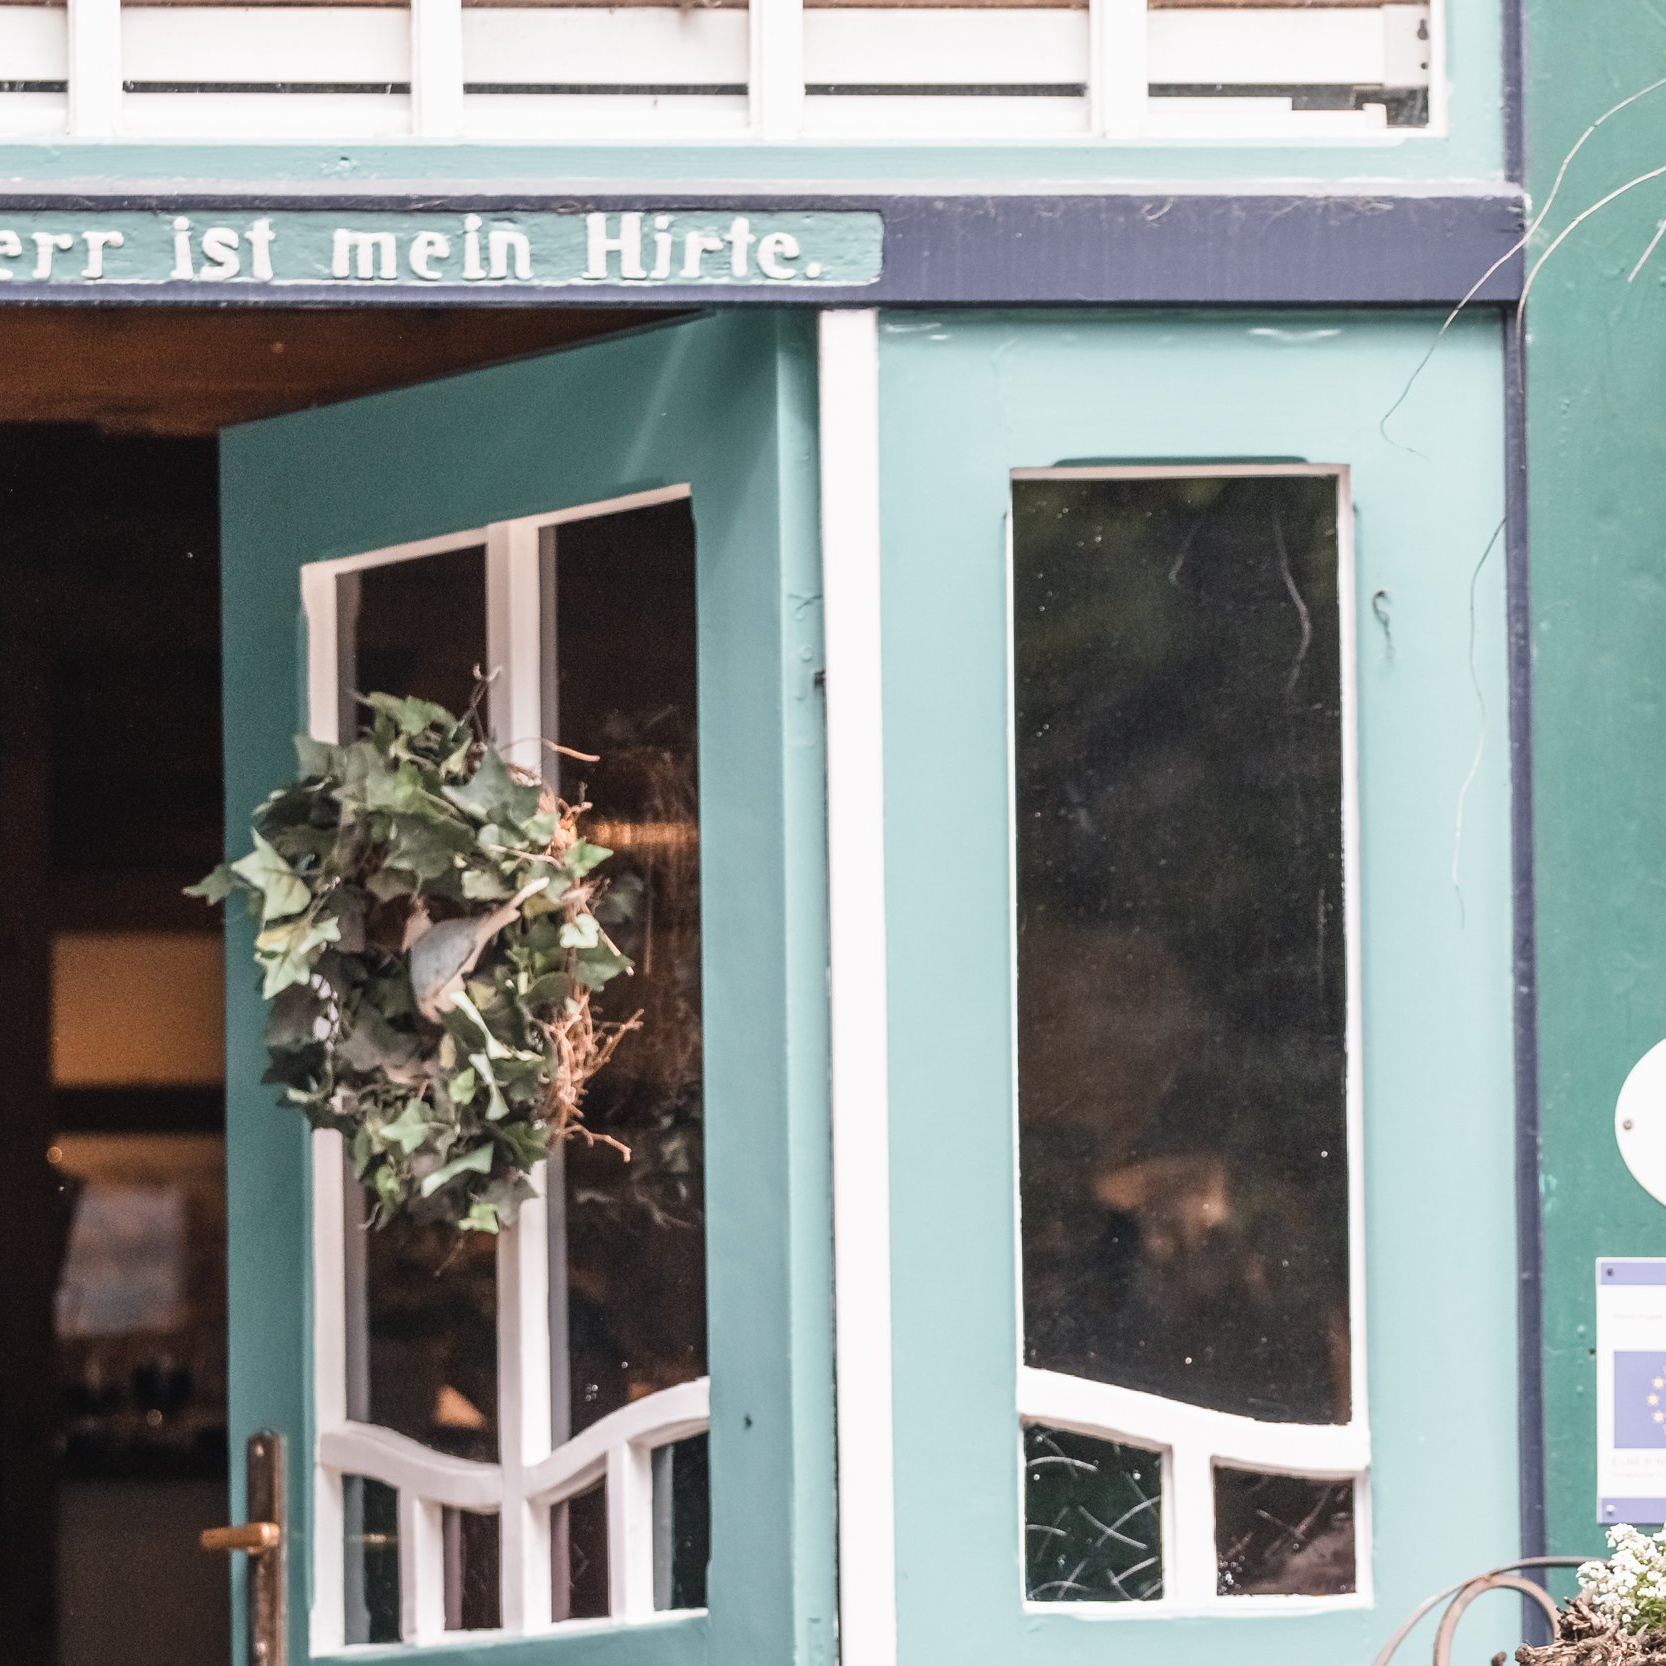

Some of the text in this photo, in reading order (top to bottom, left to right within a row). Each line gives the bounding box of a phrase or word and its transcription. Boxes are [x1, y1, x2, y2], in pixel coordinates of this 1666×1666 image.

[170, 215, 276, 281] ist
[332, 213, 534, 281] mein
[582, 212, 823, 280] Hirte.
